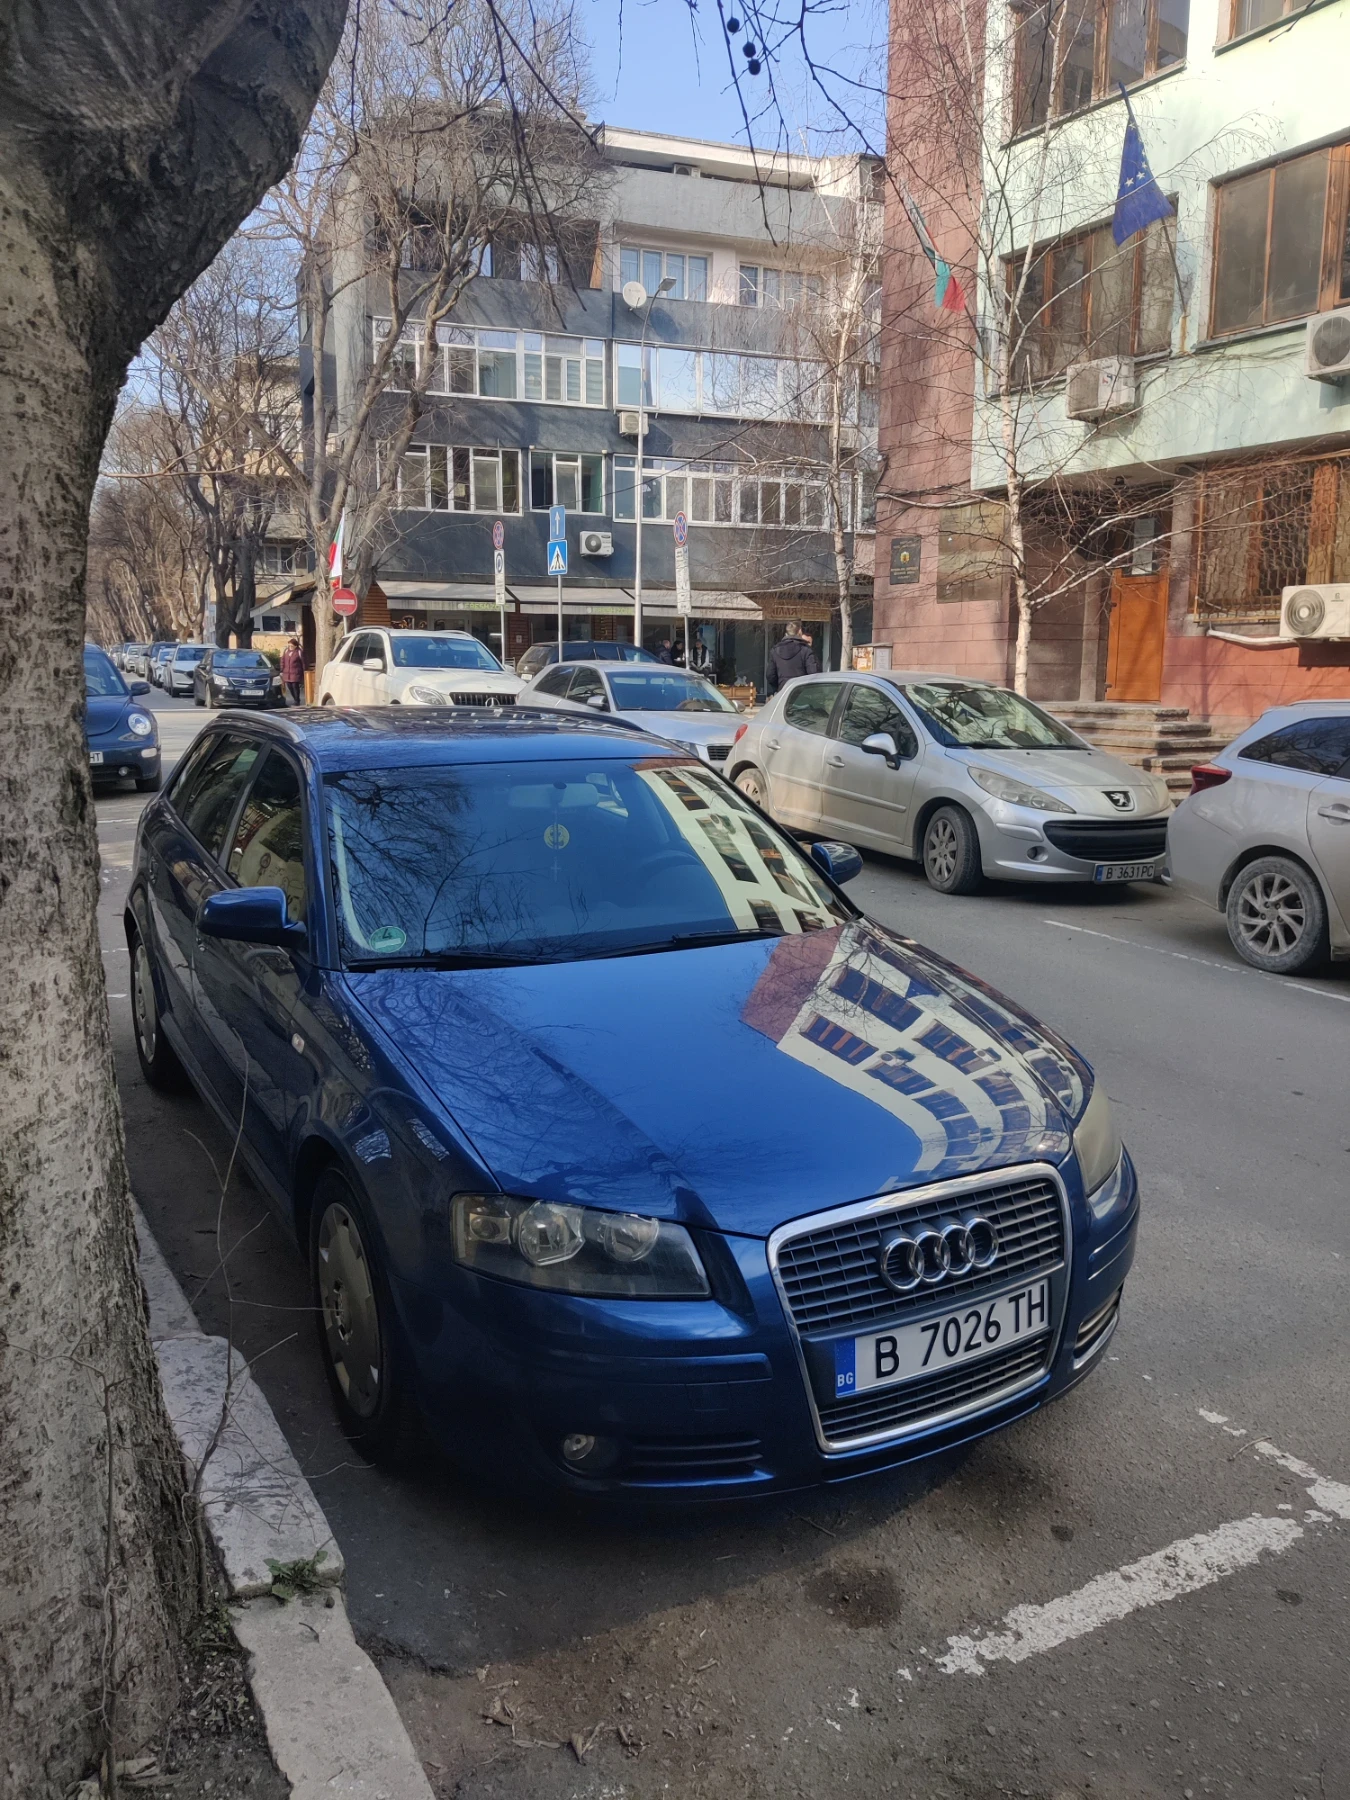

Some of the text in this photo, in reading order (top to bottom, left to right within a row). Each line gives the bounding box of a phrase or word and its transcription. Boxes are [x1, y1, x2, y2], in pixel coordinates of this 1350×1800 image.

[1105, 865, 1154, 880] B 3631 PC
[875, 1284, 1045, 1379] B 7026 TH
[837, 1372, 854, 1388] BG
